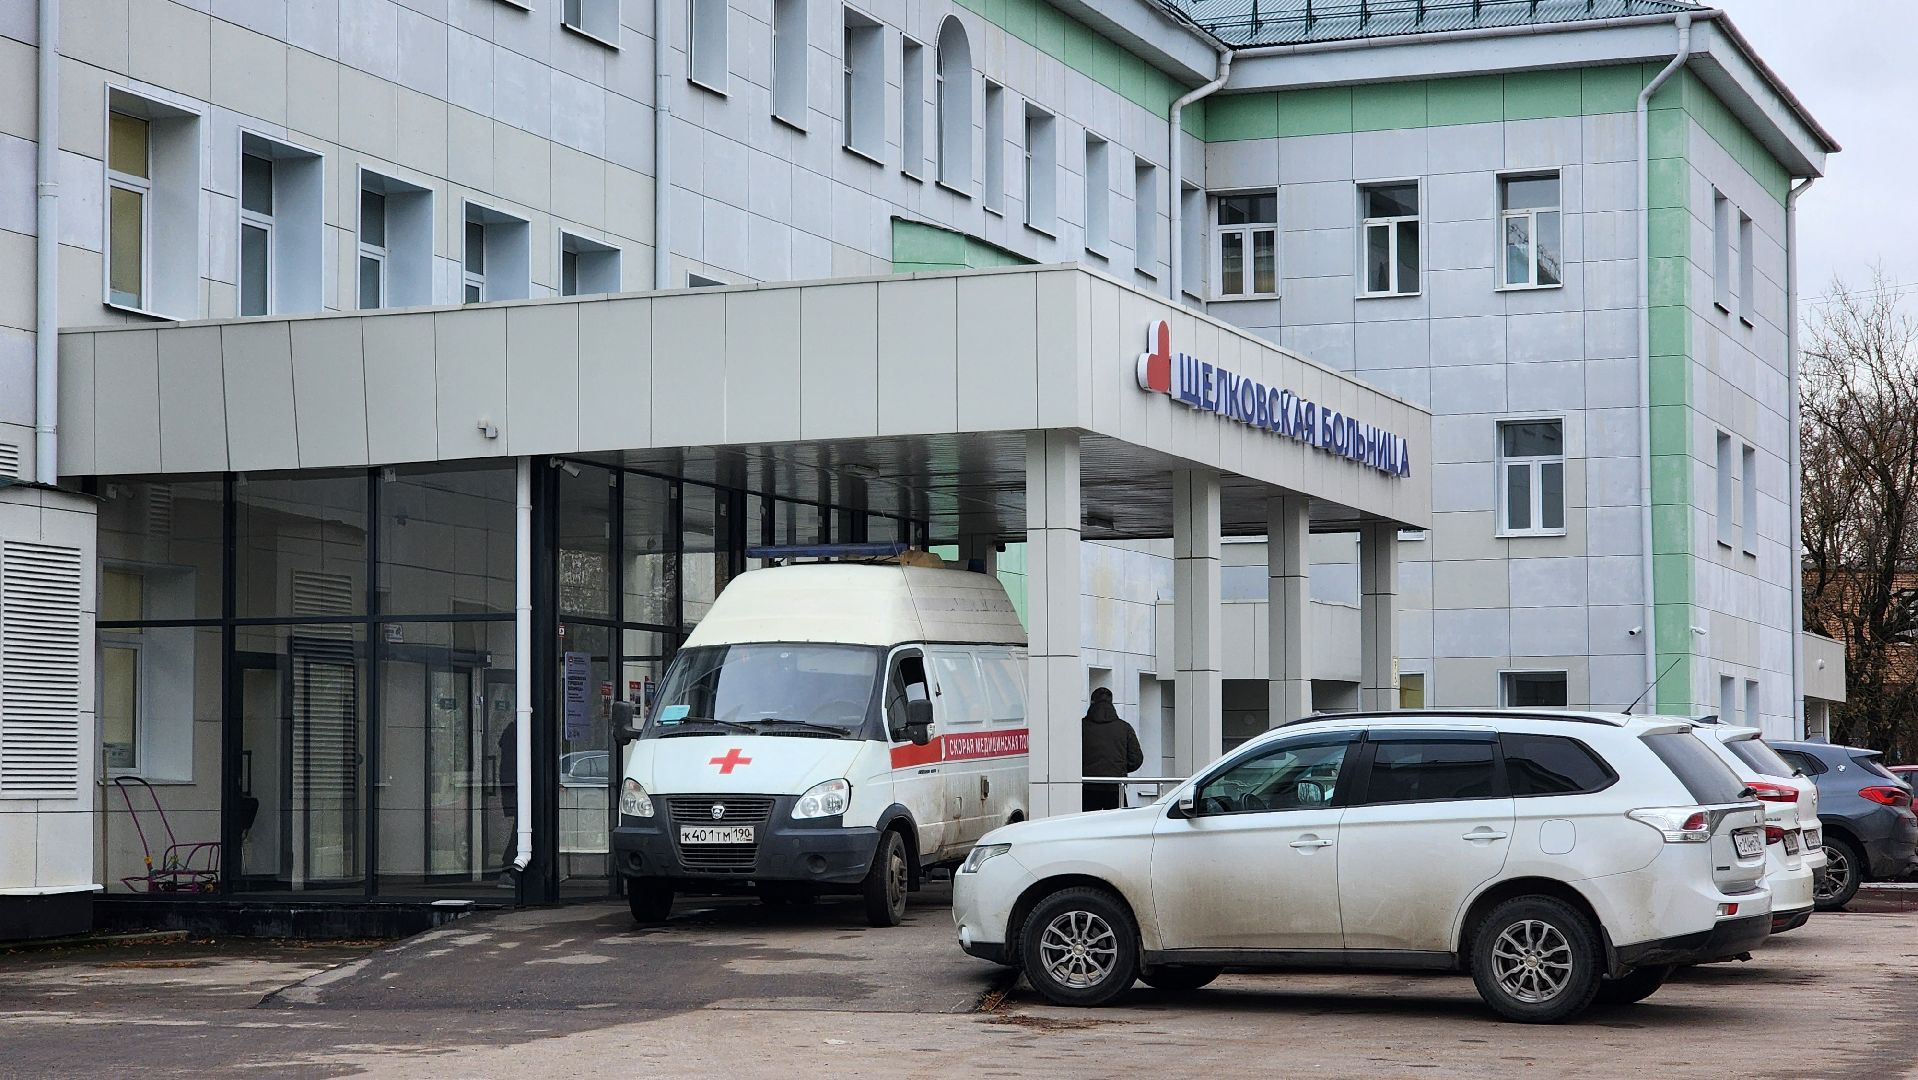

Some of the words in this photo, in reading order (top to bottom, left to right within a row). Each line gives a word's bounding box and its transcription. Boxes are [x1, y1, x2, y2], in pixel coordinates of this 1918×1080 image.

[1173, 352, 1316, 446] ЩЕЛКОВСКАЯ
[1320, 405, 1411, 478] БОЛЬНИЦА
[949, 738, 975, 756] СКОРАЯ
[975, 735, 1019, 756] МЕДИЦИНСКАЯ
[733, 828, 750, 838] 190
